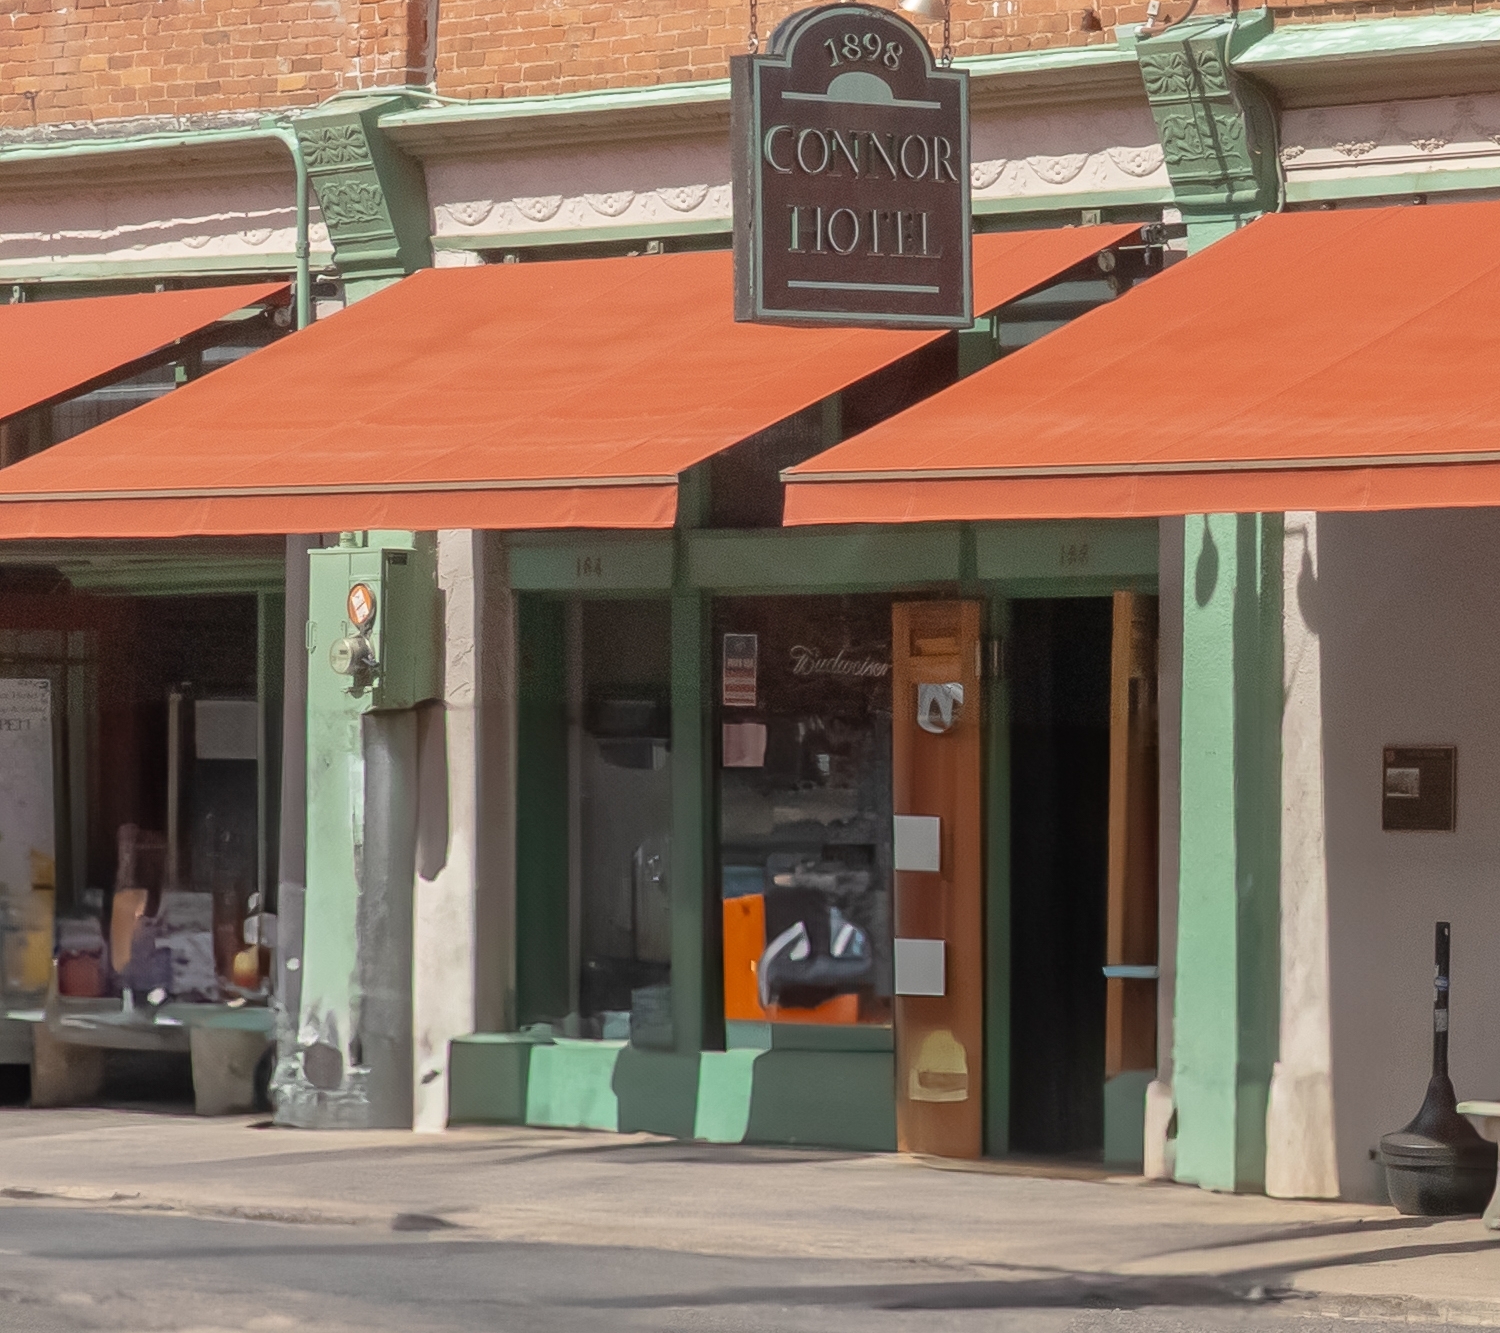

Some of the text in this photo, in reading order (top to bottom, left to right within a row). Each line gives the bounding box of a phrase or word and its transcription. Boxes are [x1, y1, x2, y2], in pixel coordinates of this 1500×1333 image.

[823, 32, 903, 71] 1898
[763, 124, 959, 183] CONNOR
[786, 204, 942, 259] HOTEL
[790, 644, 892, 677] Budweiser
